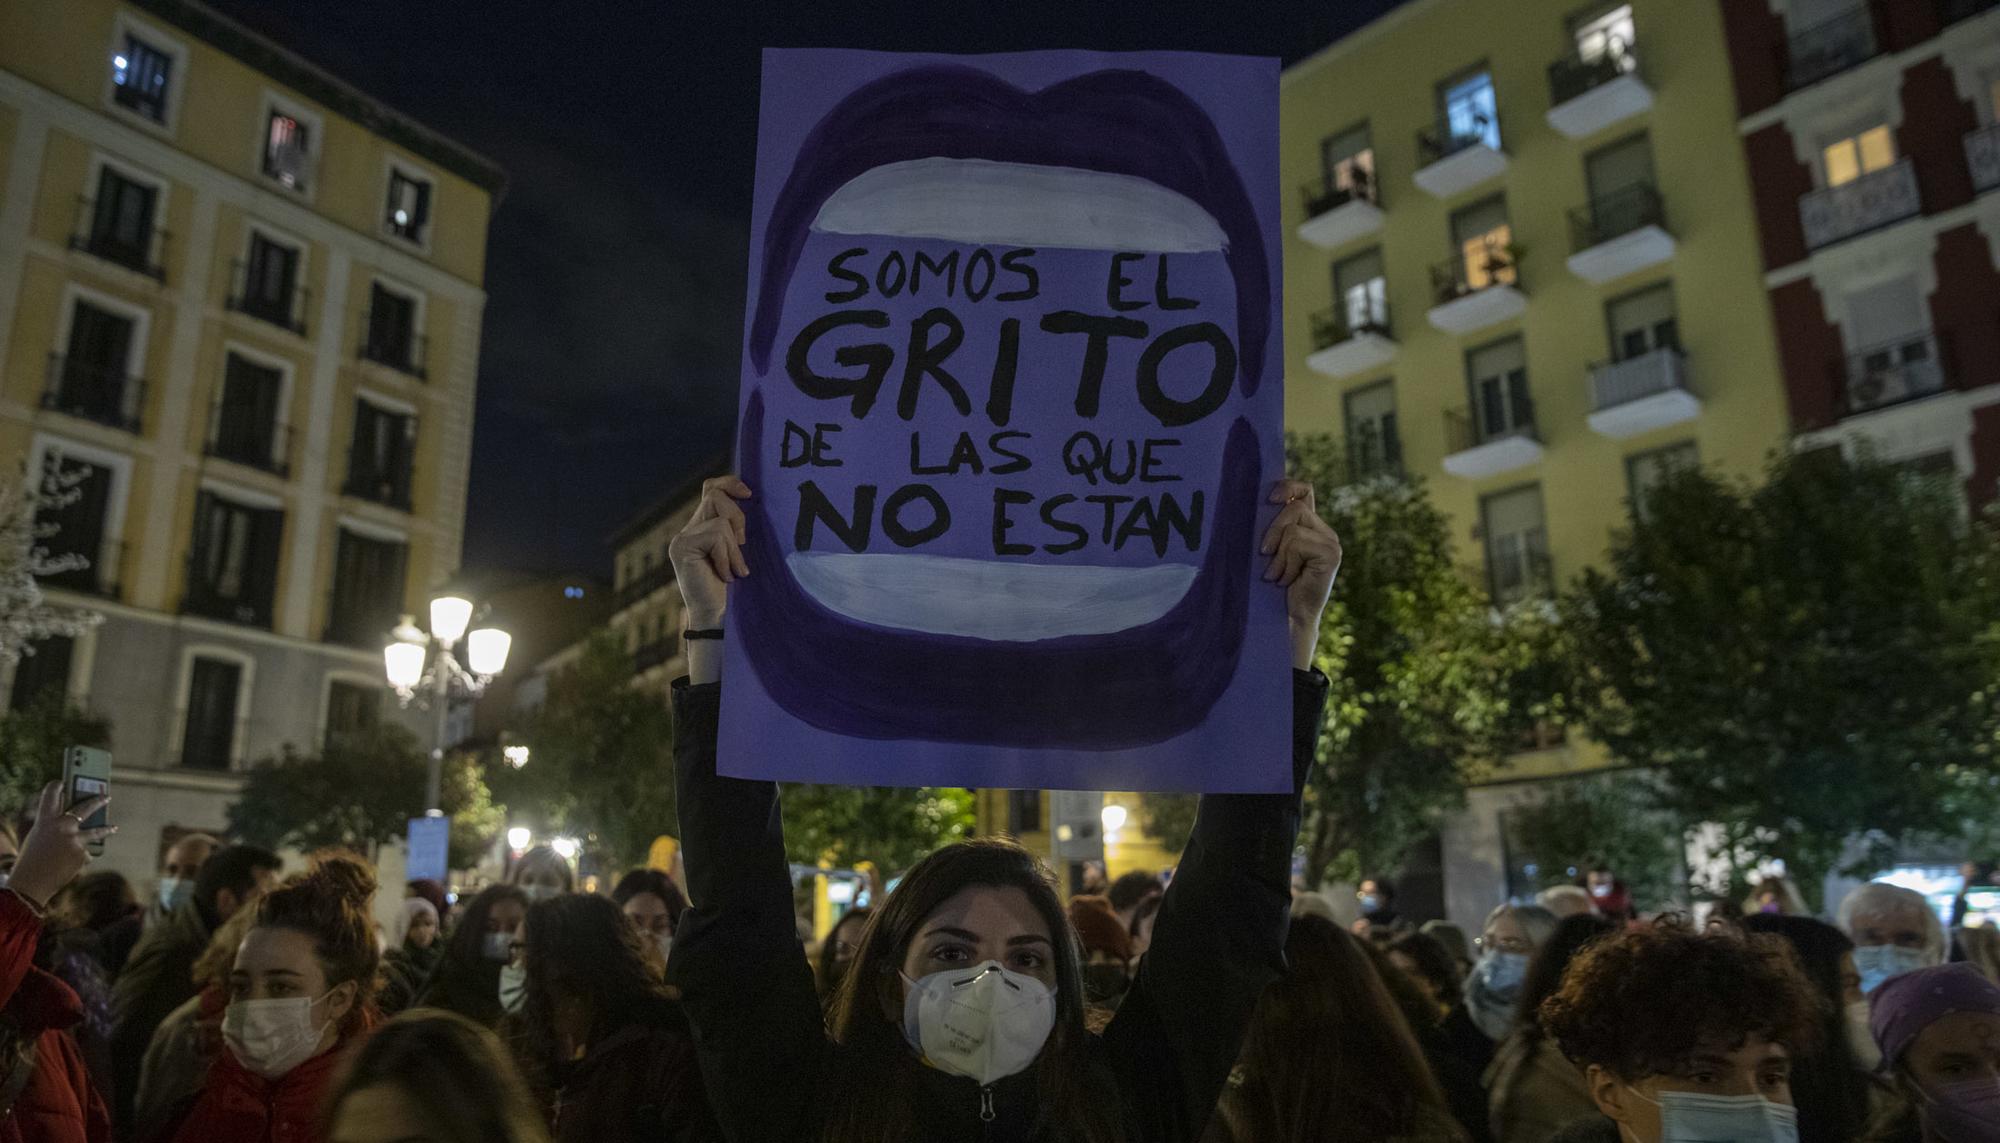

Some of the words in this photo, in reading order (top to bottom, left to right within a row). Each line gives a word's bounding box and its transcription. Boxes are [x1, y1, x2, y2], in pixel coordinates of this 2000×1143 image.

[825, 248, 1039, 302] SOMOS
[1107, 253, 1200, 310] EL
[785, 308, 1237, 427] GRITO
[780, 421, 843, 468] DE
[910, 431, 1033, 475] LAS
[1063, 430, 1183, 484] QUE
[795, 480, 951, 553] NO
[993, 488, 1205, 558] ESTAN
